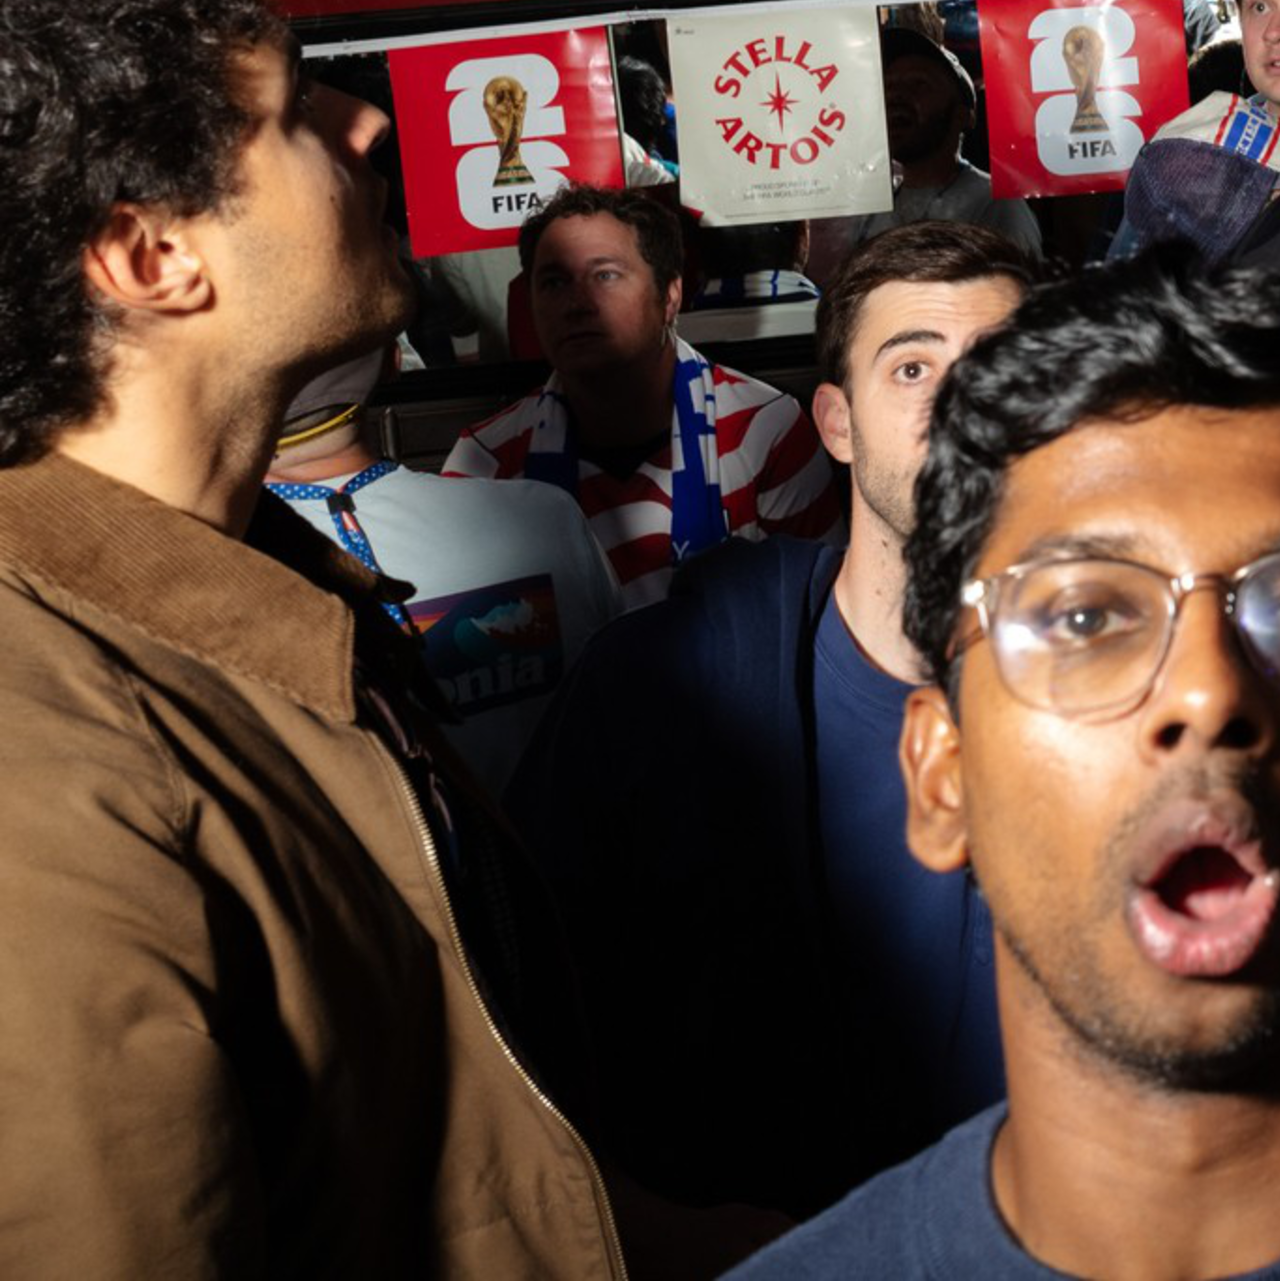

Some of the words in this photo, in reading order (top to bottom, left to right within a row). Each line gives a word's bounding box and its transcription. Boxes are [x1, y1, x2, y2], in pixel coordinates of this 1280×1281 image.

[714, 35, 839, 98] STELLA
[714, 106, 846, 170] ARTOIS
[1067, 138, 1117, 160] FIFA
[491, 193, 542, 213] FIFA
